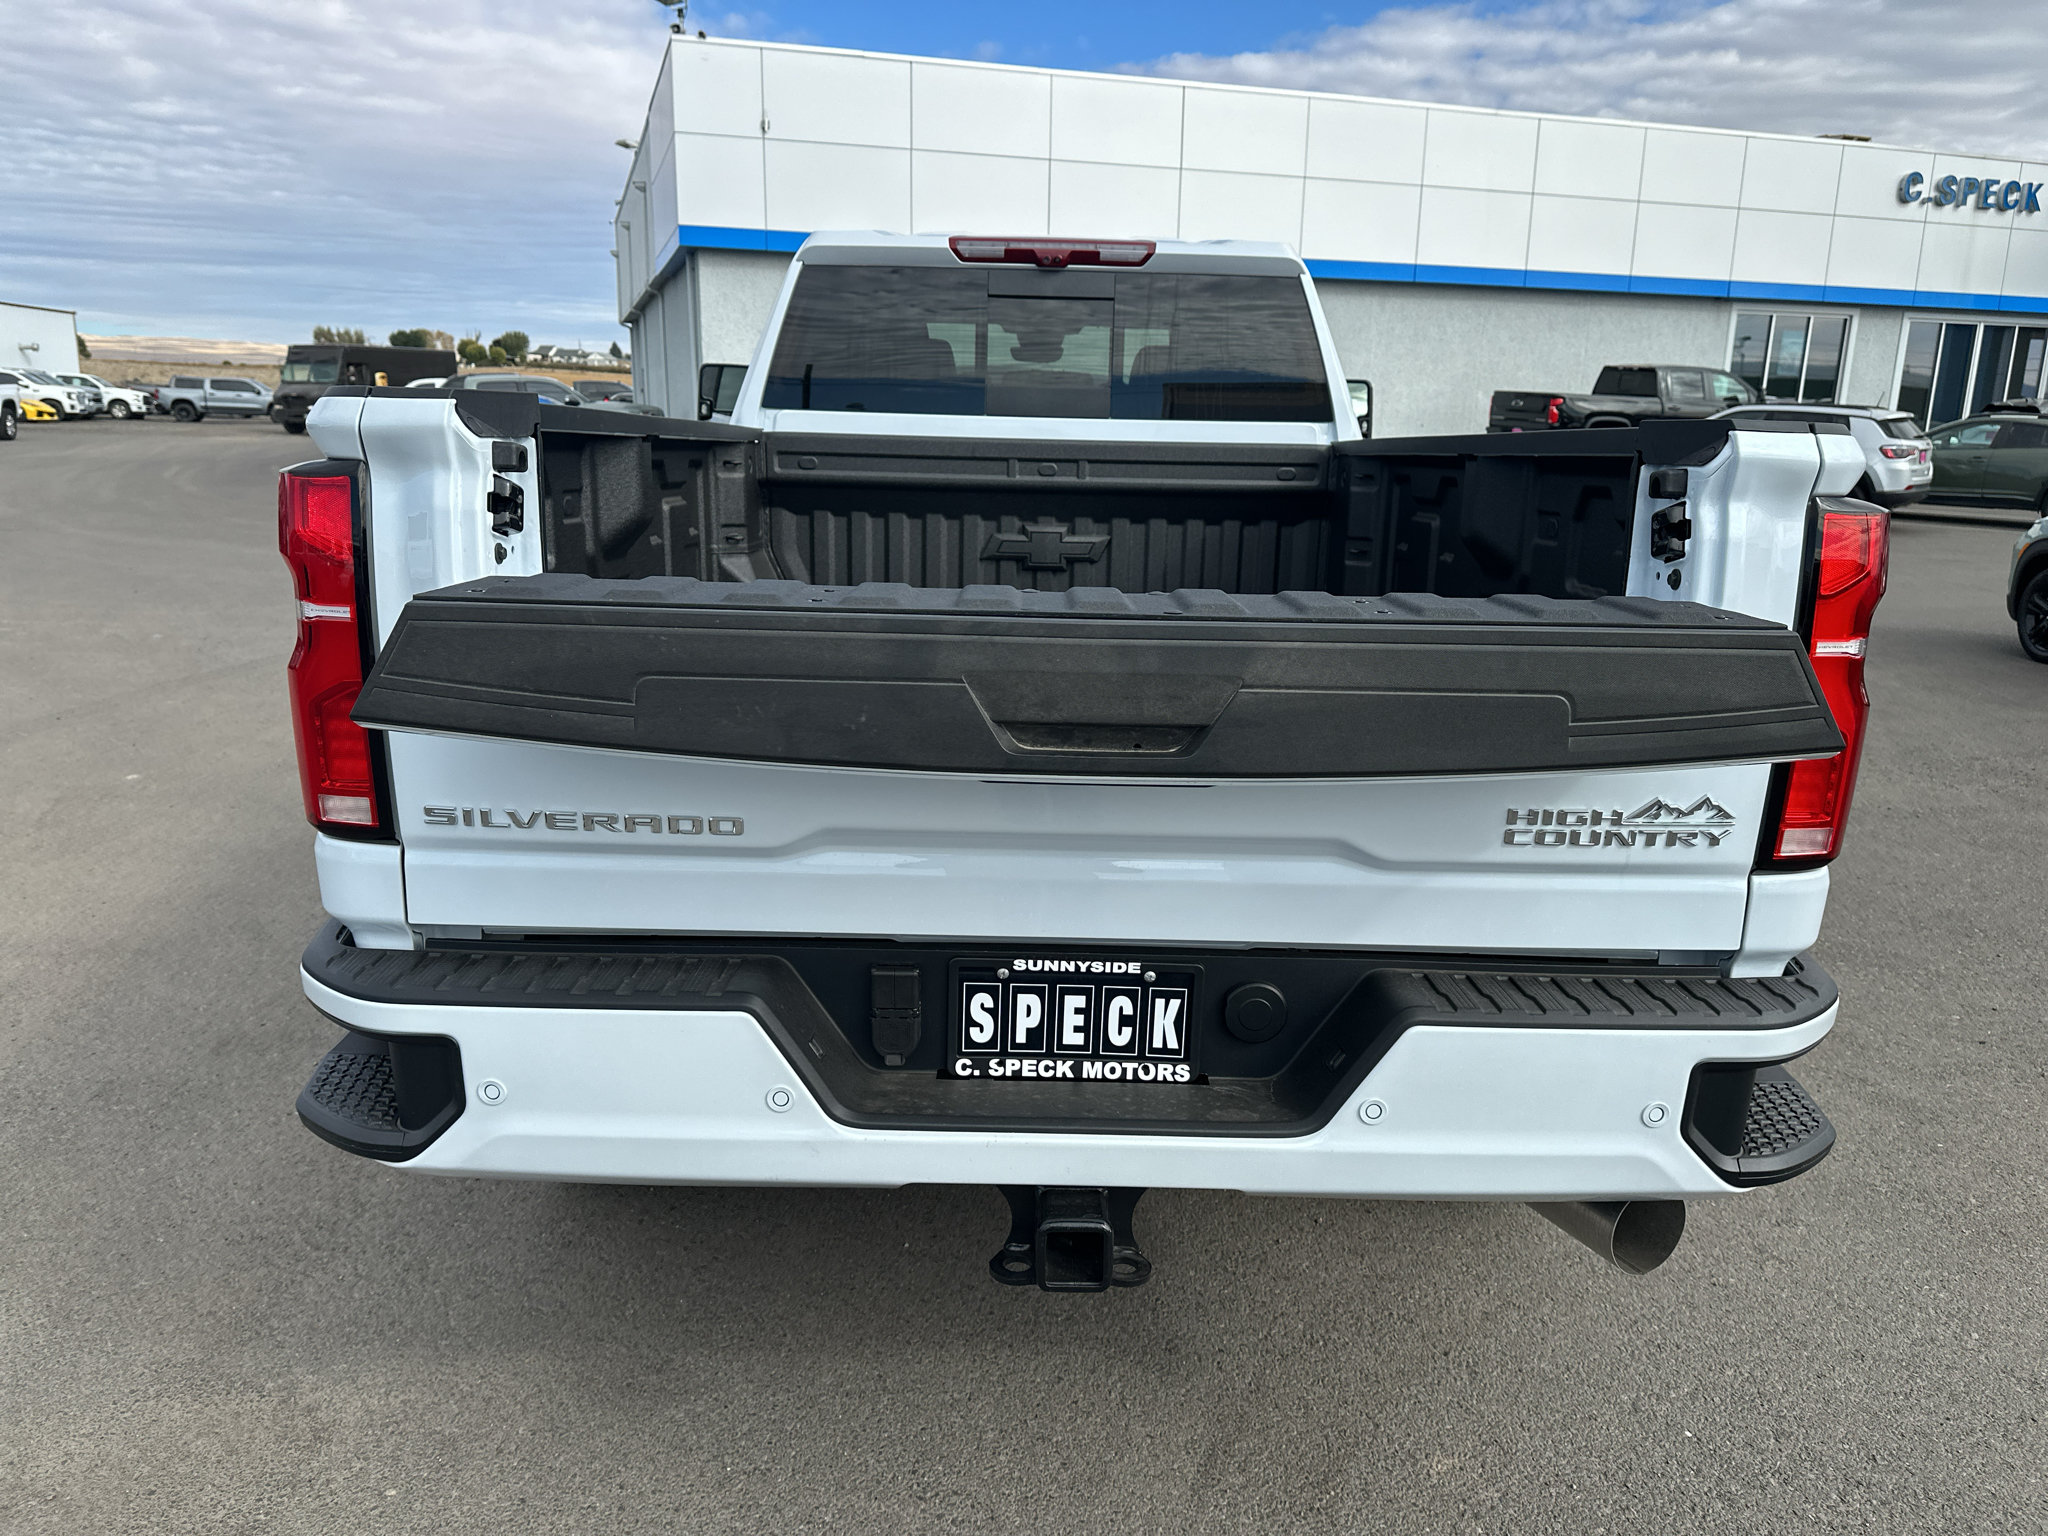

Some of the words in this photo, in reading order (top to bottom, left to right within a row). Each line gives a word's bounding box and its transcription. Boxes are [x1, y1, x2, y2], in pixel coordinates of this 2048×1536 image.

[424, 805, 745, 836] SILVERADO
[1506, 808, 1624, 826] HIGH
[1504, 829, 1733, 847] COUNTRY
[1012, 958, 1142, 975] SUNNYSIDE
[968, 992, 1182, 1050] SPECK
[954, 1058, 980, 1077] C.
[988, 1059, 1075, 1079] SPECK
[1082, 1061, 1191, 1083] MOTORS
